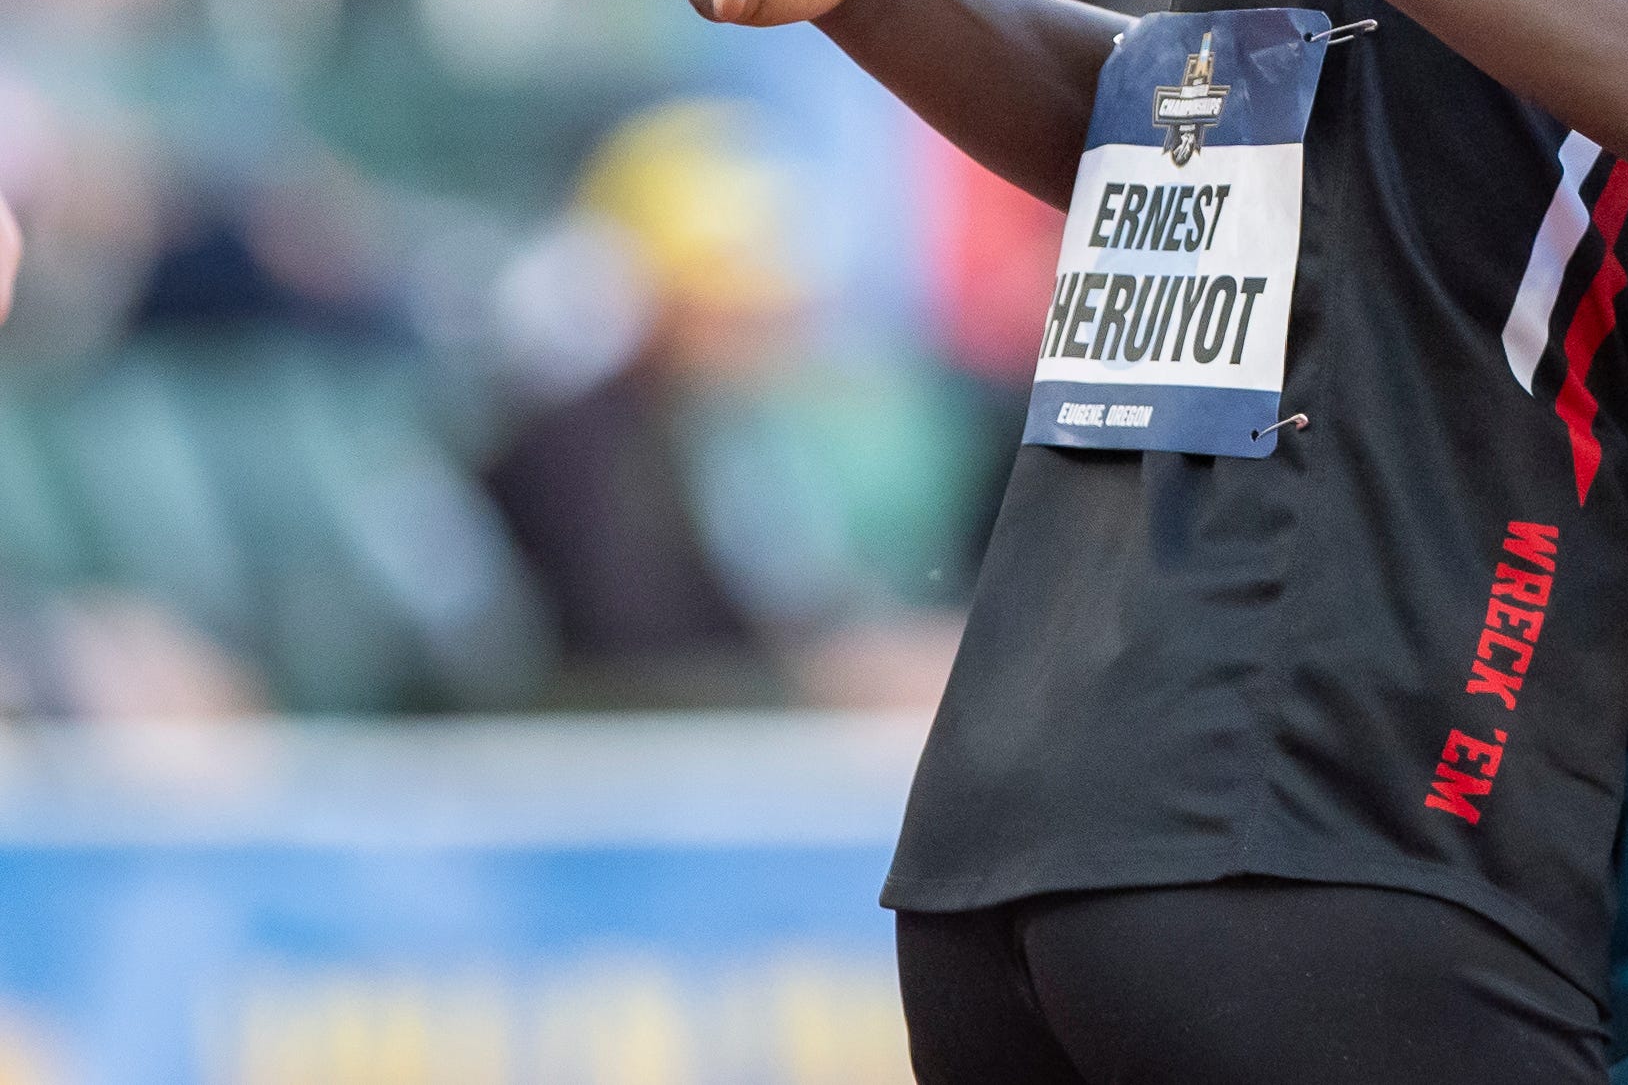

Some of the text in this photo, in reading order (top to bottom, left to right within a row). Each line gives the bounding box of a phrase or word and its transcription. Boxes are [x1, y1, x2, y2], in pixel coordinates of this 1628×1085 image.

[1088, 182, 1231, 253] ERNEST
[1040, 272, 1267, 365] HERUIYOT
[1056, 402, 1154, 428] EUGENE, OREGON
[1424, 520, 1559, 825] WRECK 'EM
